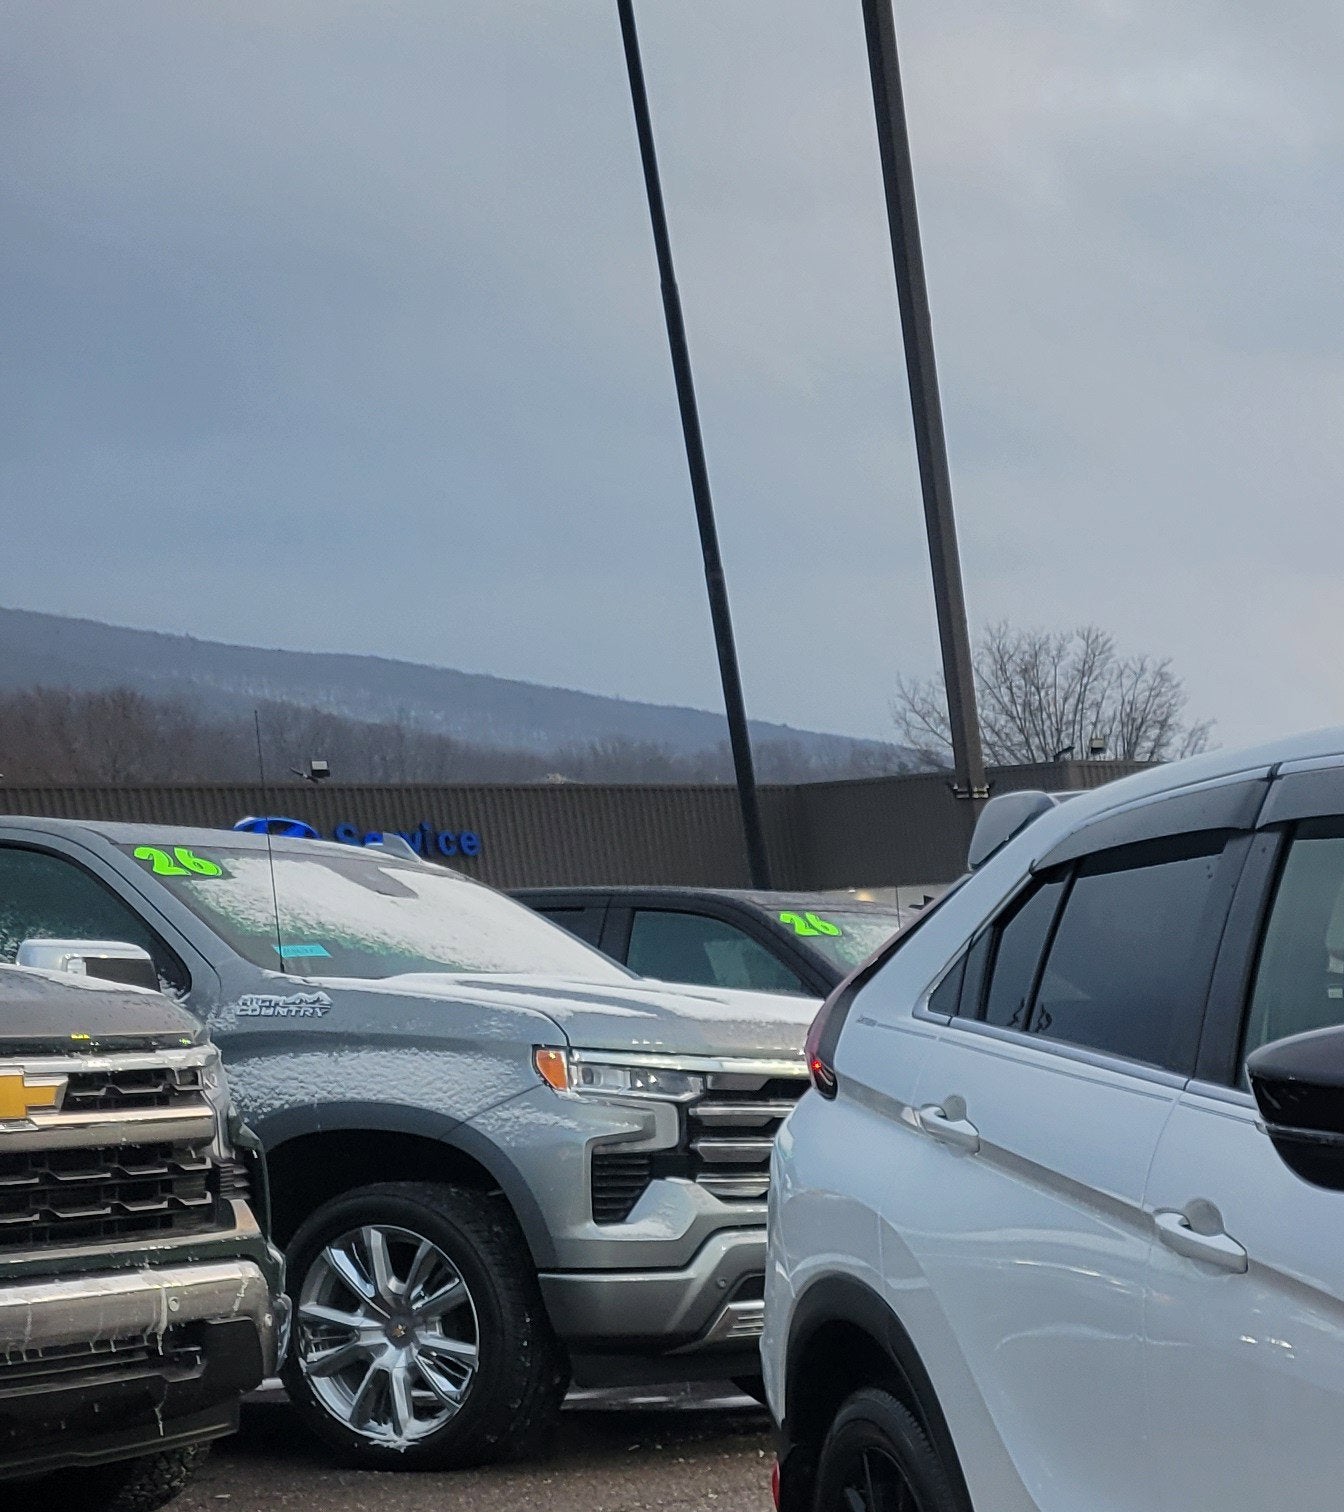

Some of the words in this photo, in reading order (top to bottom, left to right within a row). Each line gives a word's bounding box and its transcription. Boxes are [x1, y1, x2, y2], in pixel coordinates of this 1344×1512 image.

[334, 821, 482, 857] Svice
[133, 847, 223, 877] 26
[780, 912, 843, 937] 26
[236, 1004, 330, 1017] COUNTRY
